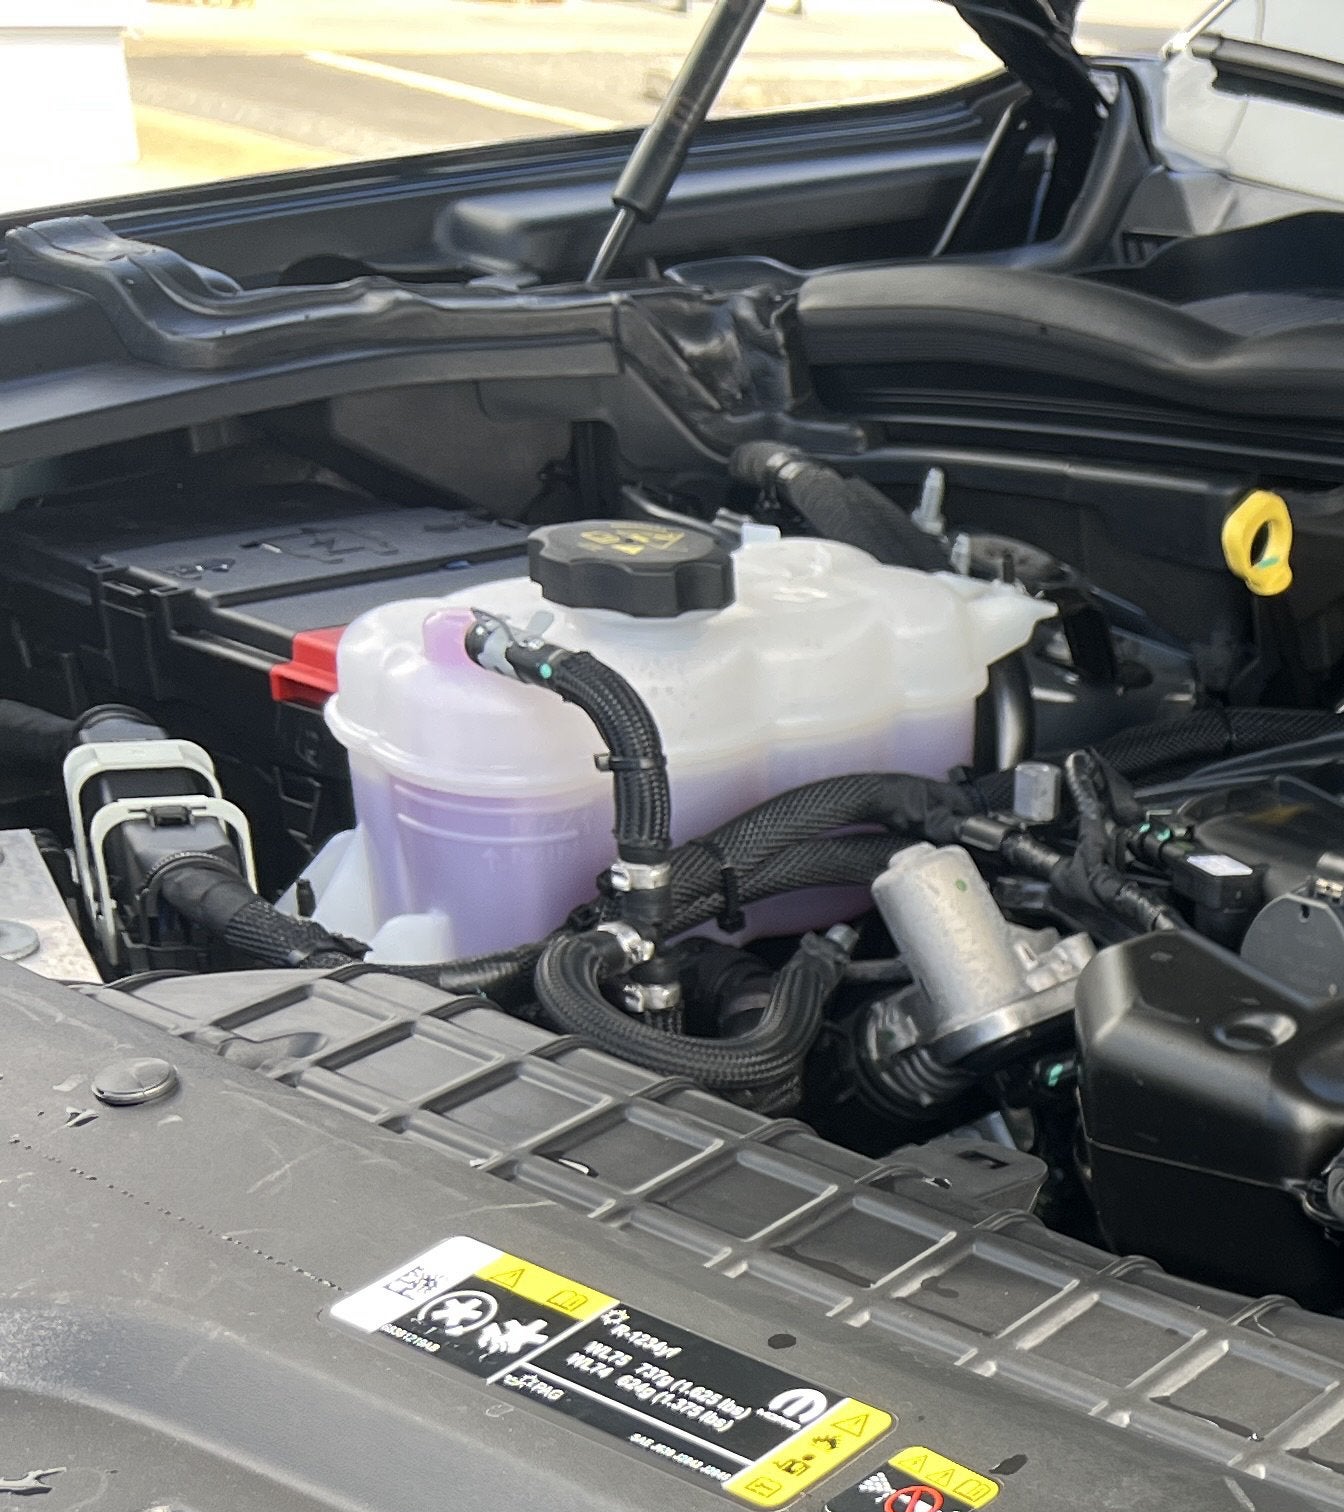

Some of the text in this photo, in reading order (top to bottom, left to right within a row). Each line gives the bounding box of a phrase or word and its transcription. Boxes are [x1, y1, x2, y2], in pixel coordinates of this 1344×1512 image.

[530, 1380, 566, 1401] PAG
[565, 1351, 615, 1379] WL74
[615, 1374, 657, 1401] 624g
[697, 1410, 735, 1433] lbs)
[583, 1340, 634, 1368] WL75
[634, 1362, 675, 1389] 737g
[717, 1397, 752, 1421] lbs)
